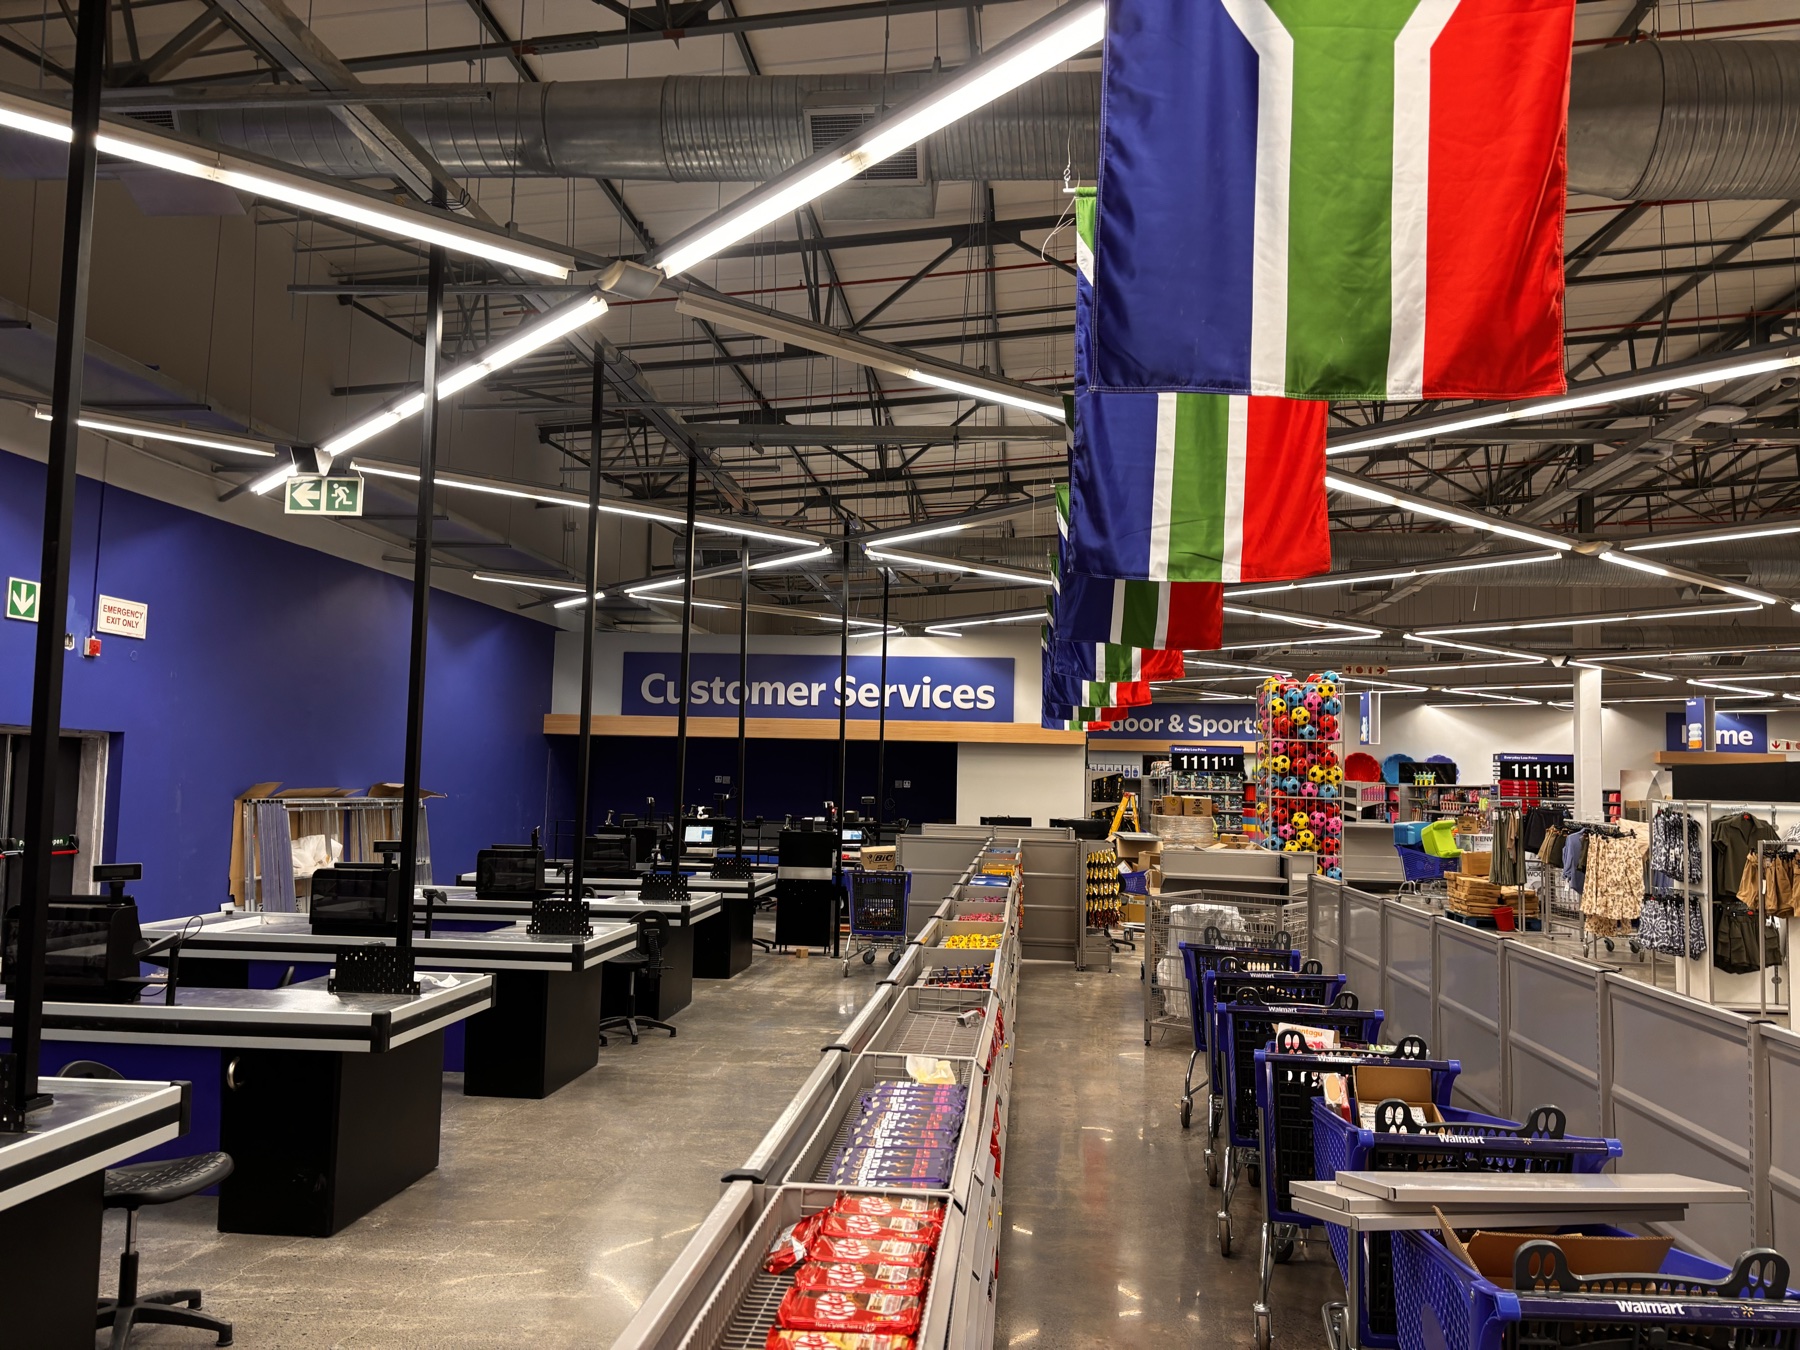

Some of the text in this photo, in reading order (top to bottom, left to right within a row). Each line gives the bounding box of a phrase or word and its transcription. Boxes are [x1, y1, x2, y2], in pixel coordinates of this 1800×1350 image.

[103, 604, 143, 619] EMERGENCY
[106, 616, 139, 628] EXIT ONLY
[640, 672, 996, 710] Customer Services
[1168, 714, 1184, 733] &
[1268, 1006, 1298, 1014] Walmart
[1438, 1134, 1485, 1144] Walmart
[1615, 1301, 1686, 1315] Walmart
